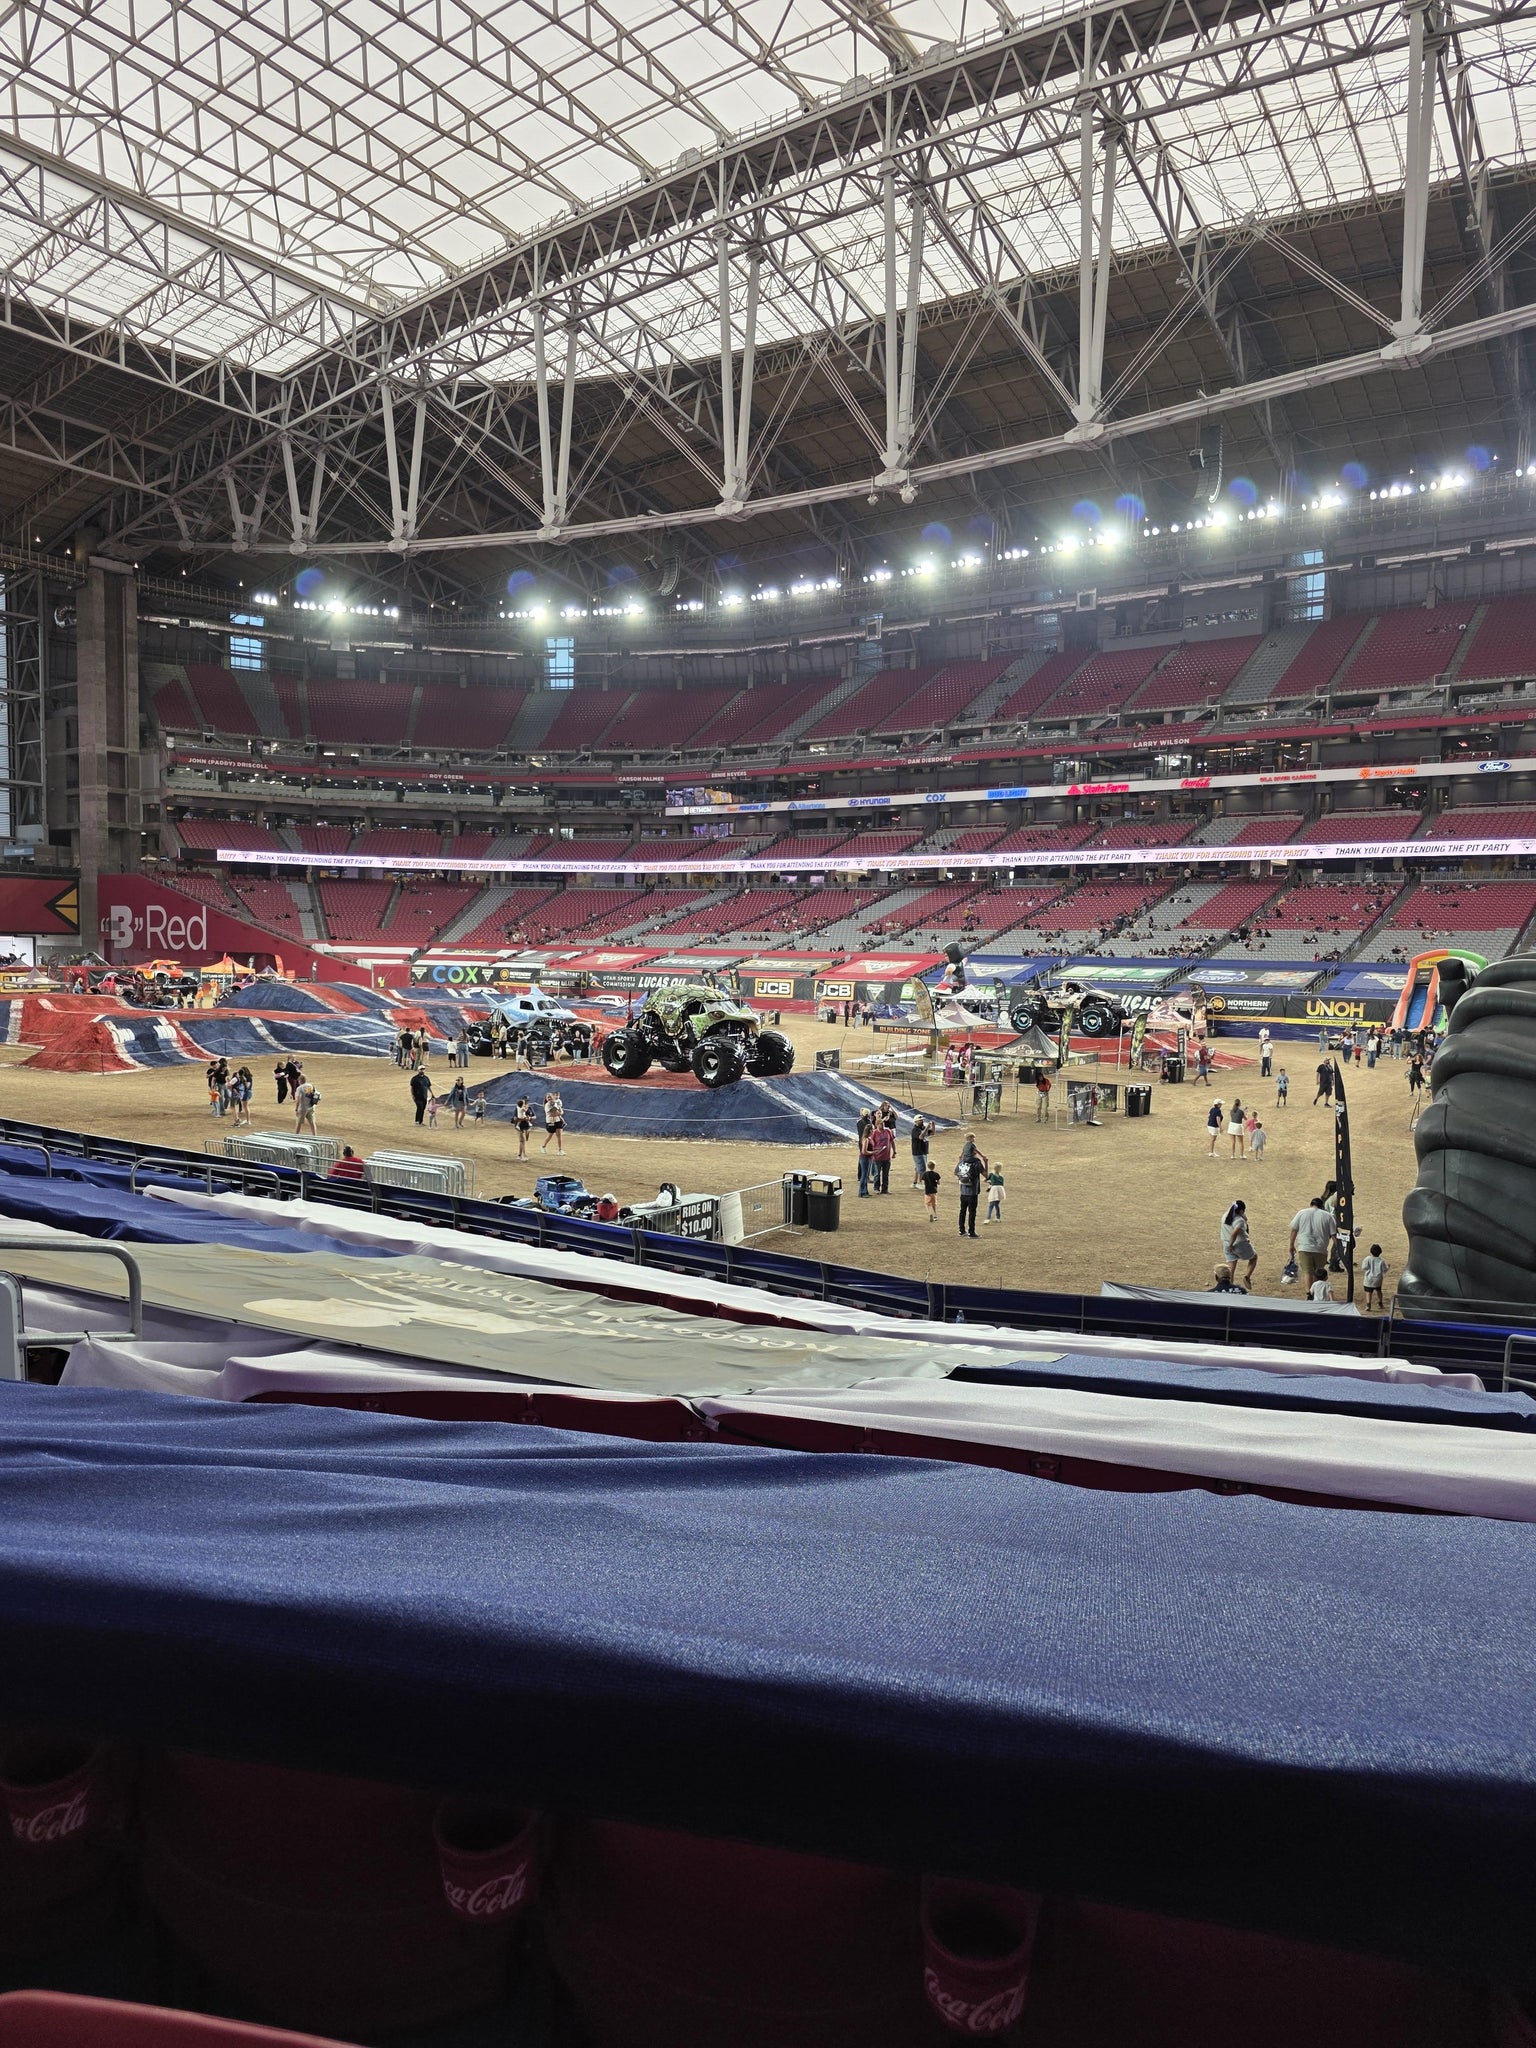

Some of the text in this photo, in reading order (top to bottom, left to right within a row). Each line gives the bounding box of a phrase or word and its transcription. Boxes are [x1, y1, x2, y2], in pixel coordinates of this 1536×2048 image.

[1133, 740, 1158, 748] LARRY
[1159, 738, 1190, 746] WILSON
[207, 759, 236, 767] (PADDY)
[237, 761, 269, 769] DRISCOLL
[921, 756, 952, 764] DIERDORF
[859, 797, 891, 805] HYUNDAI
[925, 793, 946, 803] COX
[1180, 851, 1194, 859] YOU
[1195, 851, 1210, 859] FOR
[1252, 850, 1268, 858] THE
[1283, 849, 1309, 857] PARTY
[1335, 843, 1511, 855] THANK YOU FOR ATTENDING THE PIT PARTY
[147, 905, 207, 950] Red
[432, 965, 479, 984] COX
[638, 977, 669, 988] LUCAS
[757, 983, 790, 994] JCB
[822, 984, 852, 997] JCB
[1121, 995, 1163, 1010] UCAS
[1306, 998, 1364, 1017] UNOH
[879, 1026, 912, 1034] BUILDING
[682, 1200, 712, 1219] RIDE ON
[681, 1216, 712, 1237] $10.00
